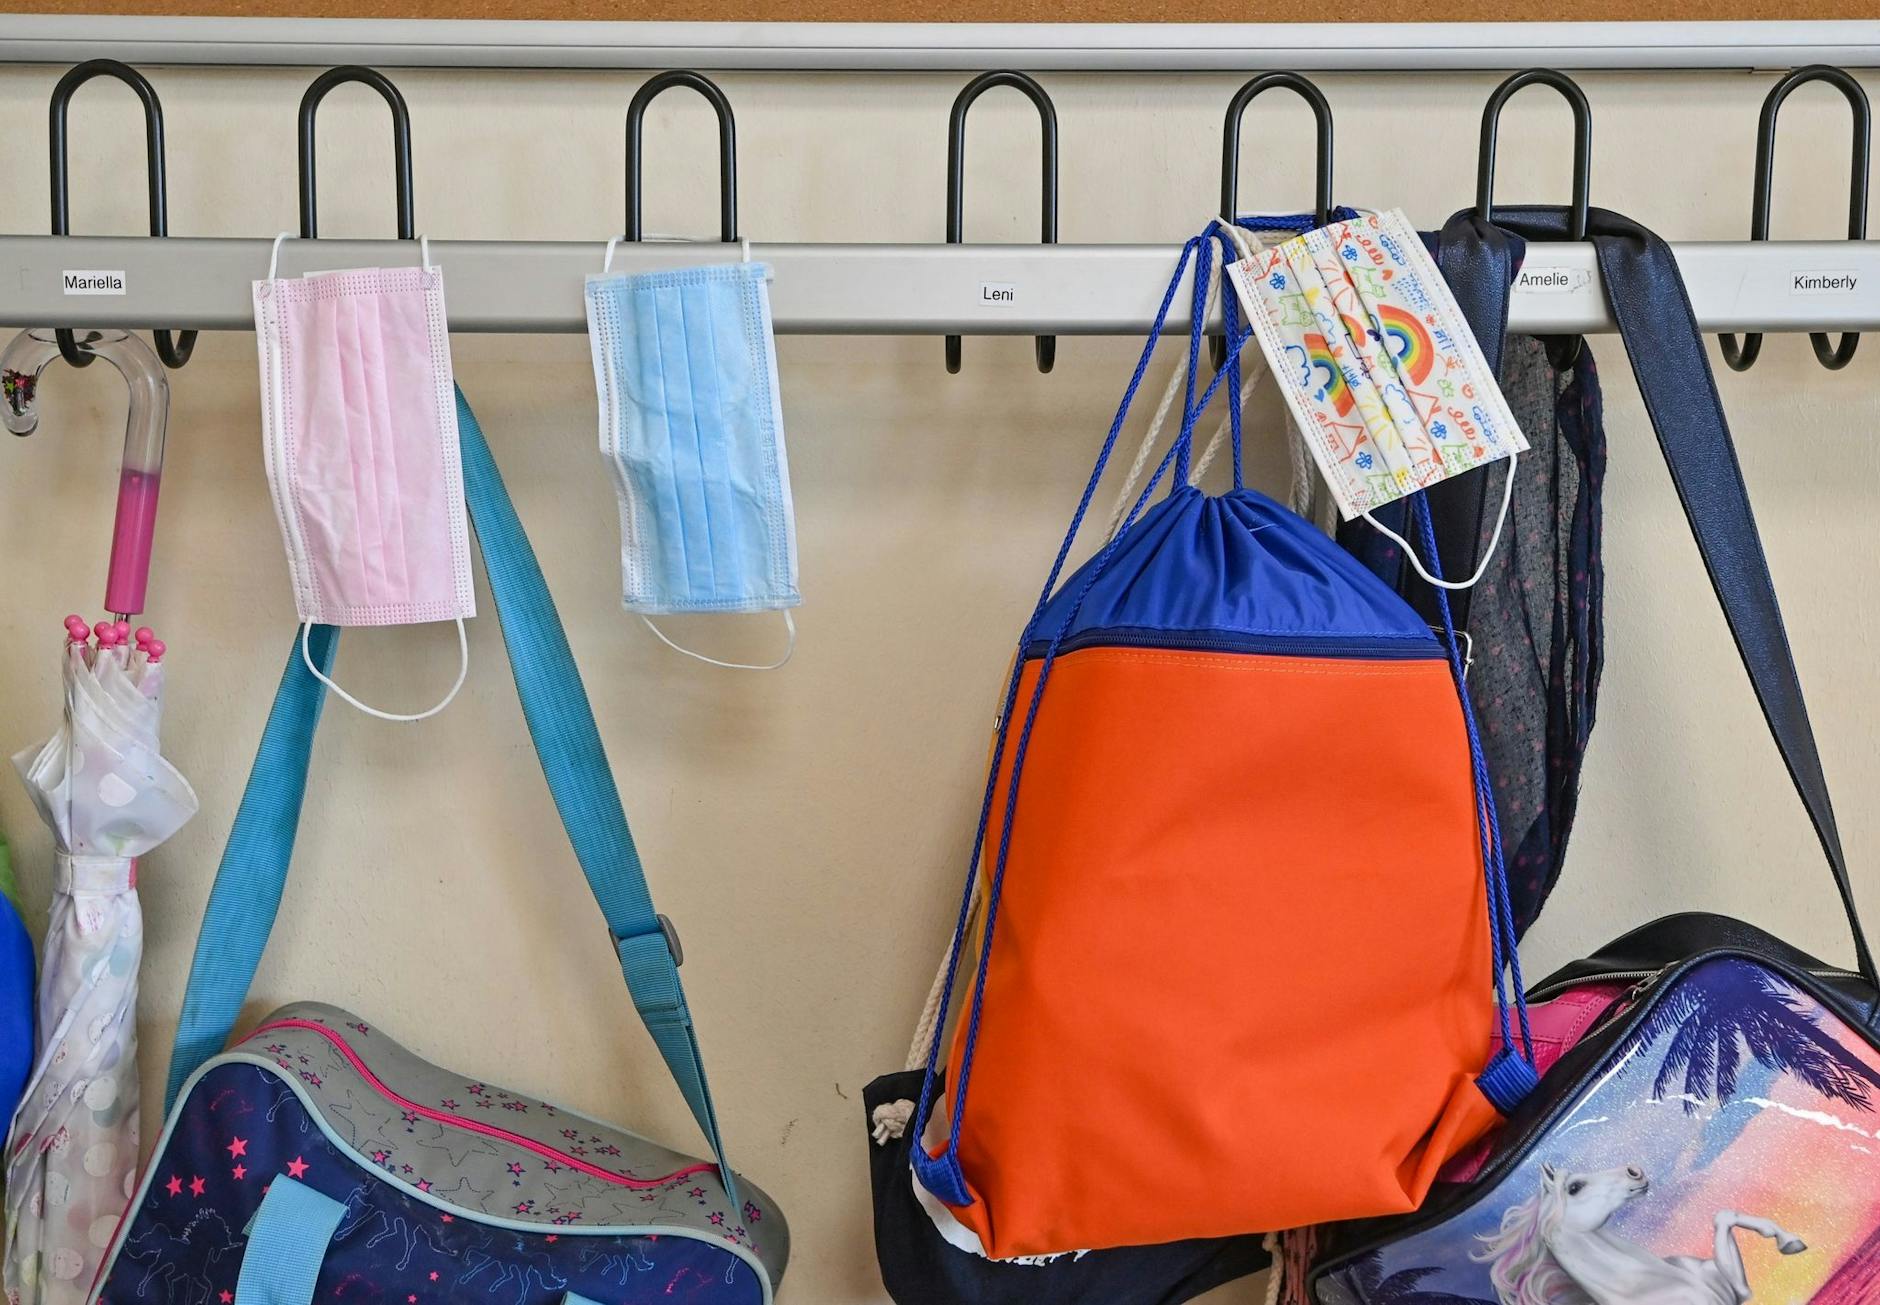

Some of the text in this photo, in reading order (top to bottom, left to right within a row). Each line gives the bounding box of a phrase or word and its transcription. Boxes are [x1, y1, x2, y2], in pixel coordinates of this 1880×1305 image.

[64, 275, 122, 289] Mariella
[1519, 272, 1569, 286] Amelie
[1794, 275, 1857, 290] Kimberly
[983, 286, 1014, 301] Leni
